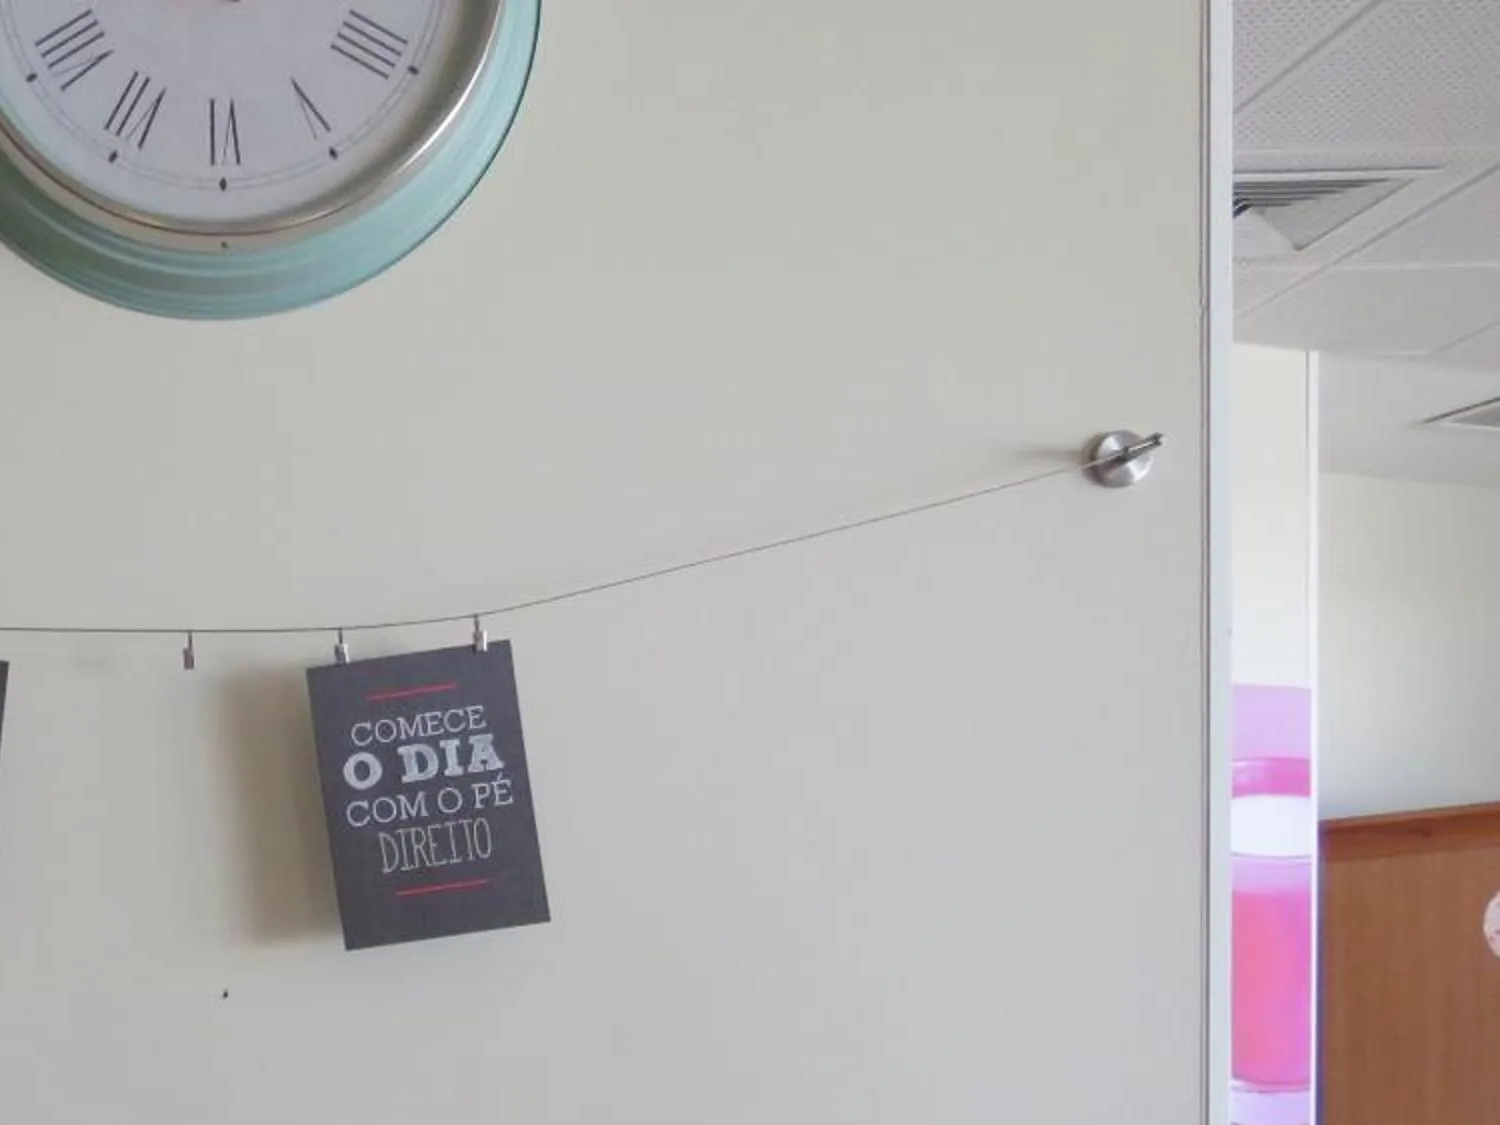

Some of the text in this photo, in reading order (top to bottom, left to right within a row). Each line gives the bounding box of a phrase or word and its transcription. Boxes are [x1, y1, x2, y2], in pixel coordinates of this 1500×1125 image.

[351, 705, 488, 746] COMECE
[342, 733, 505, 790] O DIA
[345, 772, 514, 827] COM O PÉ
[377, 817, 493, 875] DIREITO
